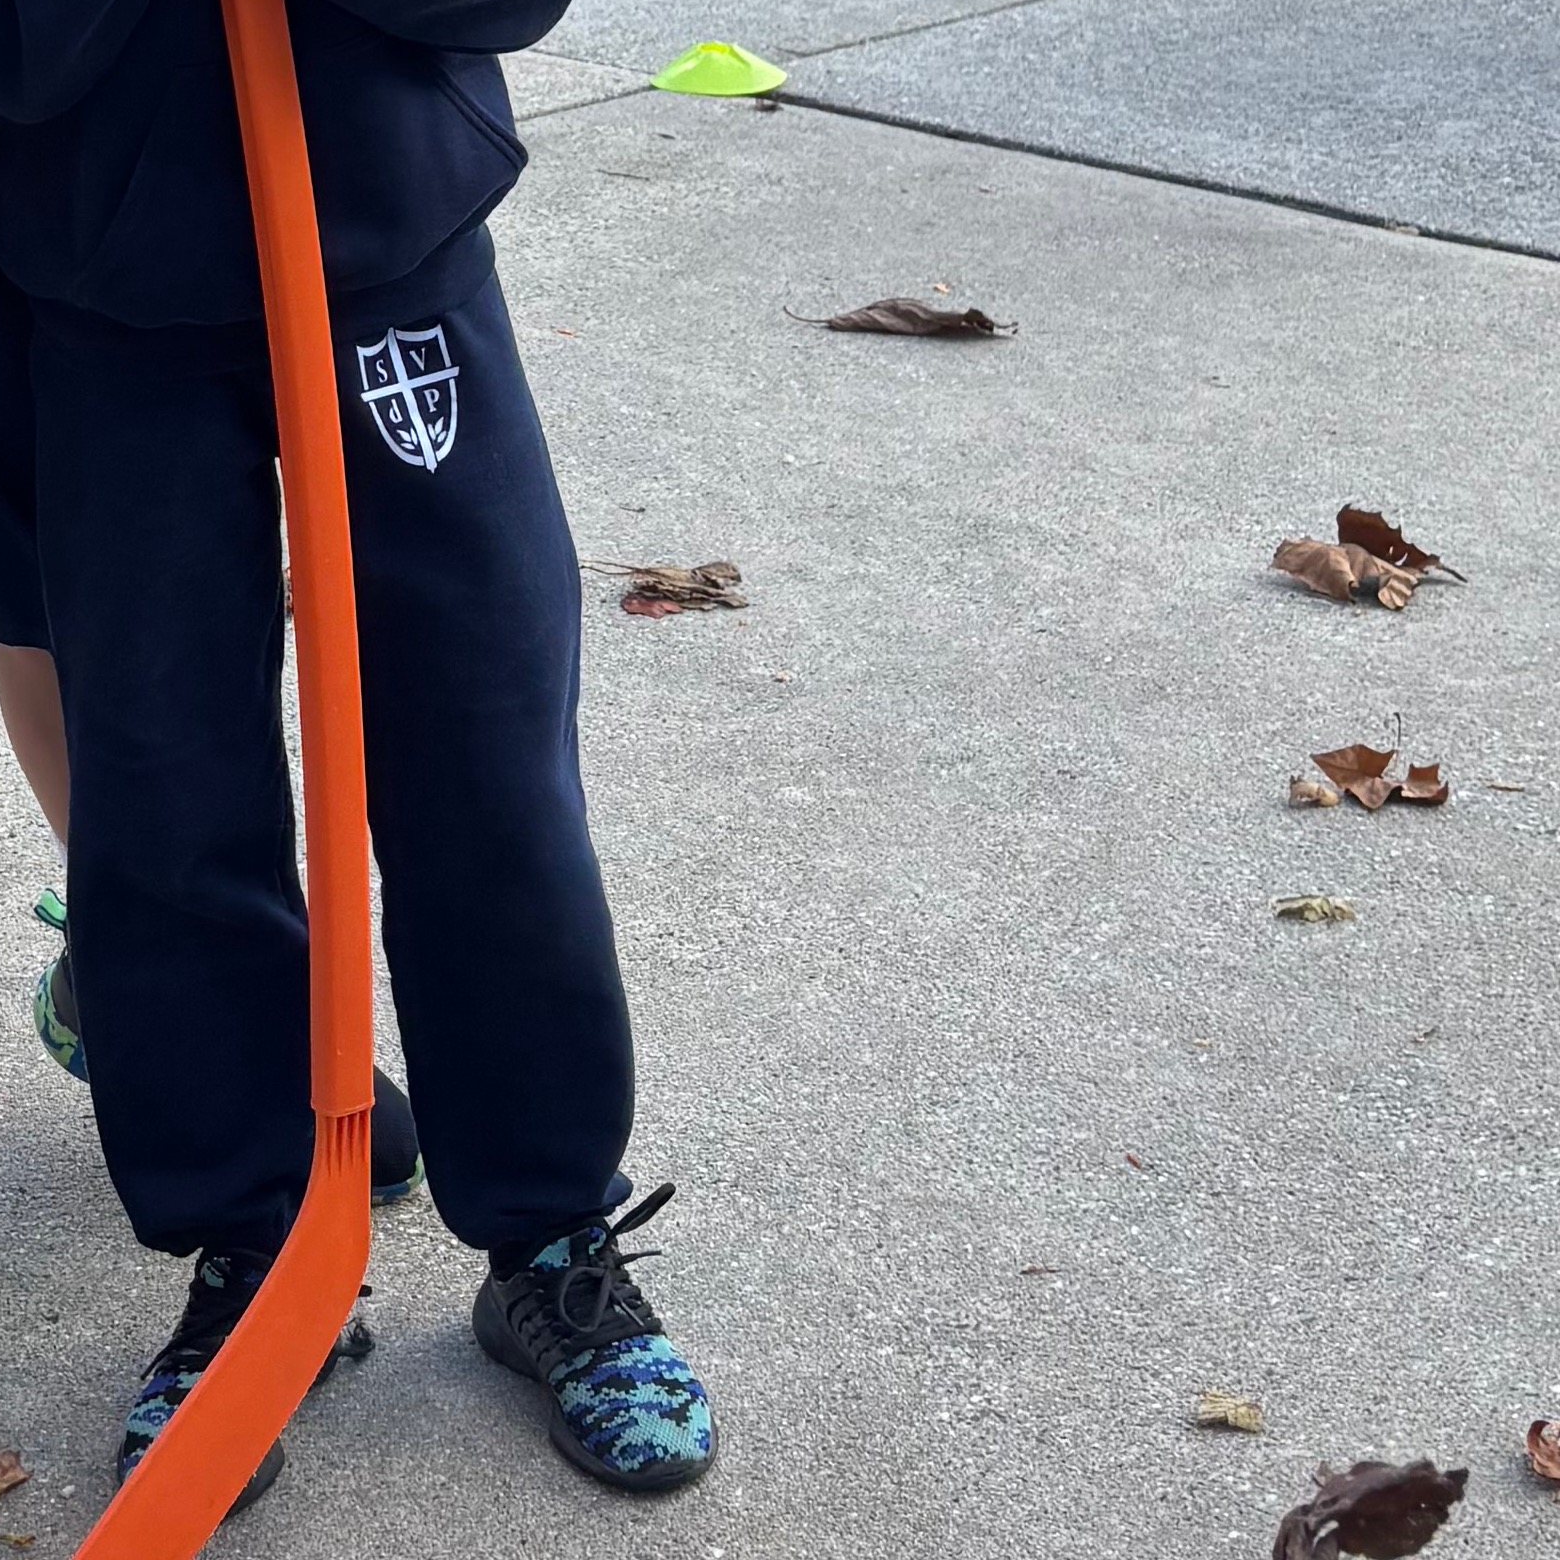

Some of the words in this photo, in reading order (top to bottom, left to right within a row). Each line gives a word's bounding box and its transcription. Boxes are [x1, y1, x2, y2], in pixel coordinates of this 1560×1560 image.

[375, 359, 388, 383] S
[409, 347, 425, 371] V
[389, 398, 403, 423] d
[423, 388, 439, 412] P
